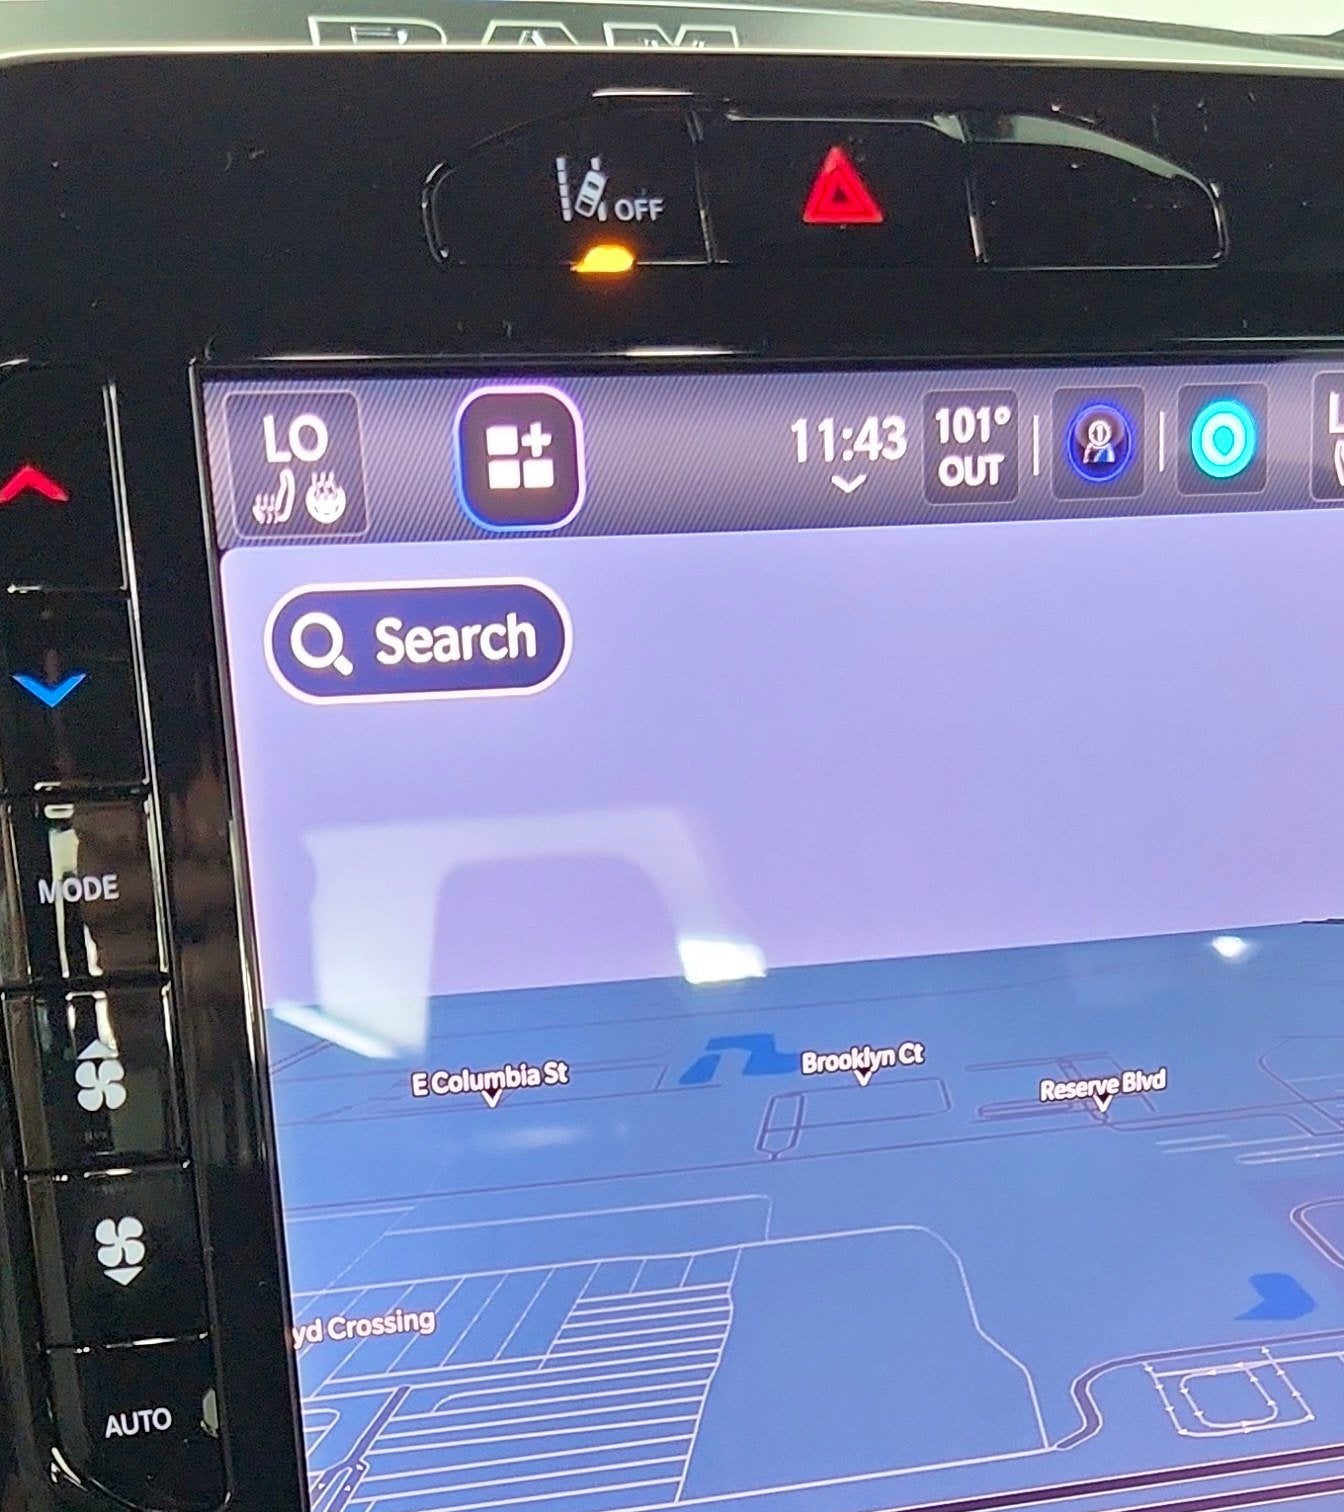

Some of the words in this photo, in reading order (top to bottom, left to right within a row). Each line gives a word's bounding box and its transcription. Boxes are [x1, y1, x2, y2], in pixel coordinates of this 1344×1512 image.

[613, 198, 665, 222] OFF
[262, 413, 329, 464] LO
[789, 415, 908, 463] 11:43
[937, 454, 1005, 488] OUT
[375, 612, 538, 665] Search
[38, 873, 120, 904] MODE
[801, 1046, 896, 1075] Brooklyn
[898, 1042, 925, 1065] Ct
[411, 1072, 430, 1097] E
[431, 1061, 542, 1095] Columbia
[544, 1060, 570, 1084] St
[1039, 1074, 1120, 1102] Reserve
[1122, 1067, 1167, 1093] Blvd
[327, 1308, 436, 1340] Crossing
[105, 1406, 172, 1438] AUTO
